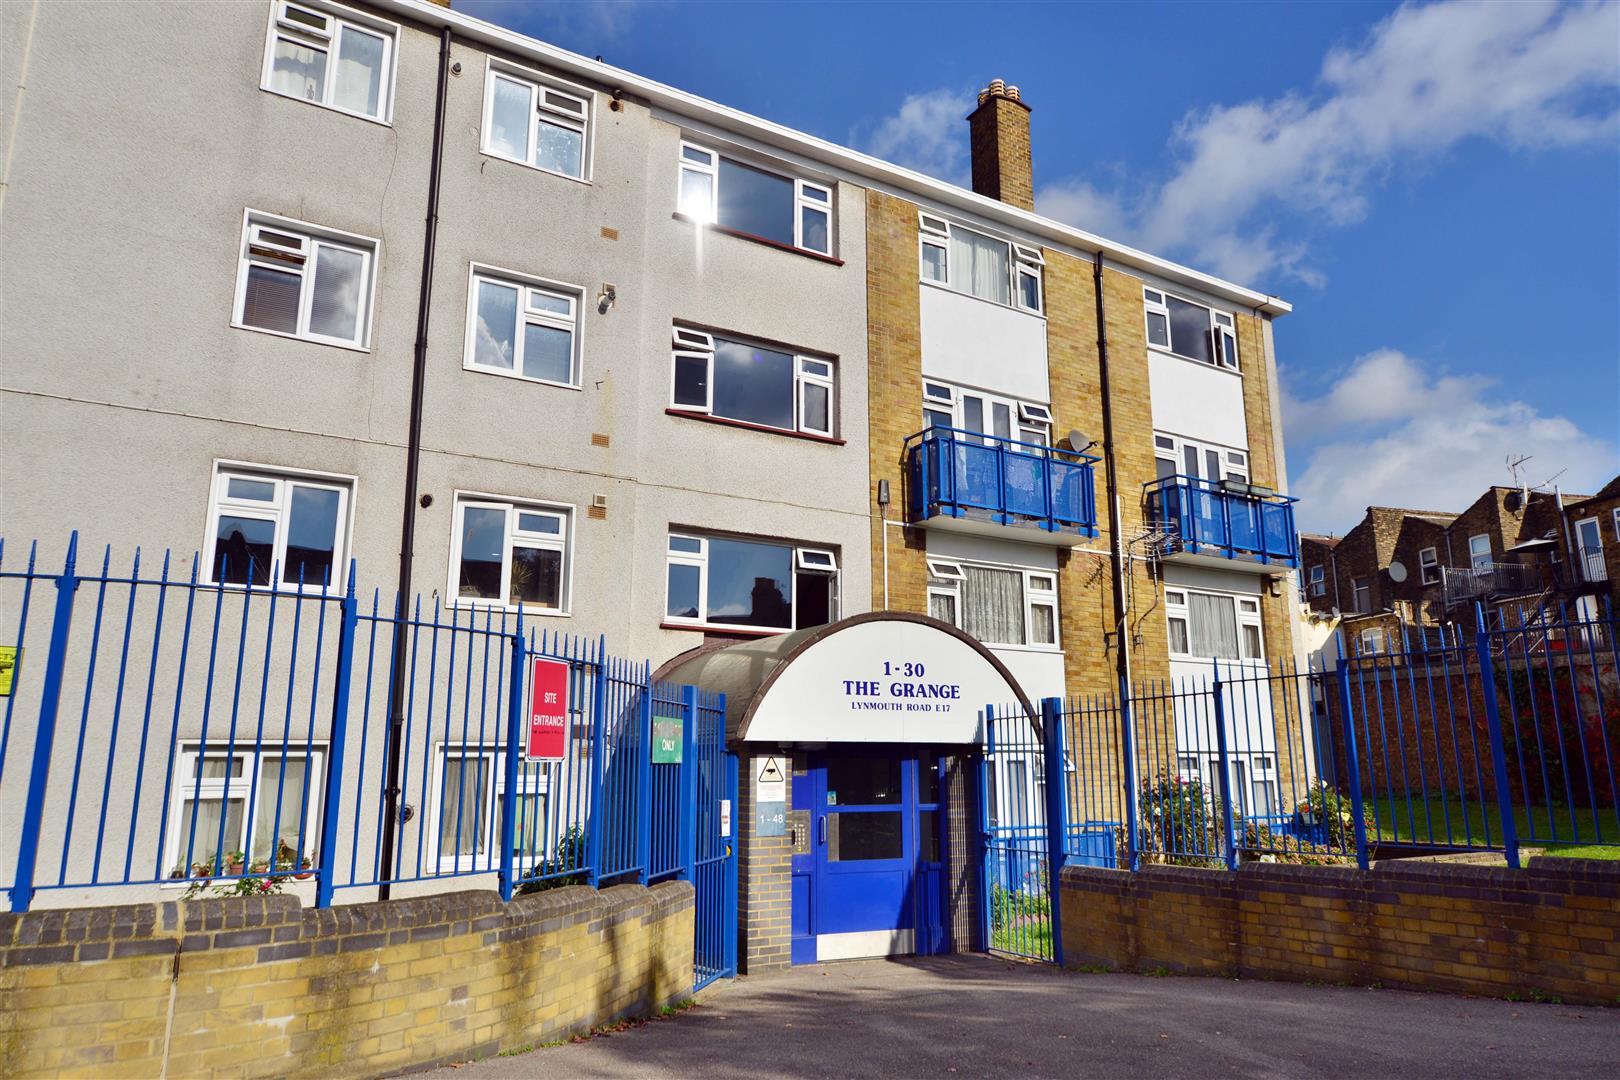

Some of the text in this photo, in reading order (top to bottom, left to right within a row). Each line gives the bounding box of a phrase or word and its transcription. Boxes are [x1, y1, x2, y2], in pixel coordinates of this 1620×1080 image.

[842, 680, 961, 699] THE GRANGE
[544, 692, 557, 704] SITE
[851, 701, 903, 711] LYNMOUTH
[906, 703, 932, 712] ROAD
[534, 714, 564, 727] ENTRANCE
[661, 739, 675, 751] ONLY
